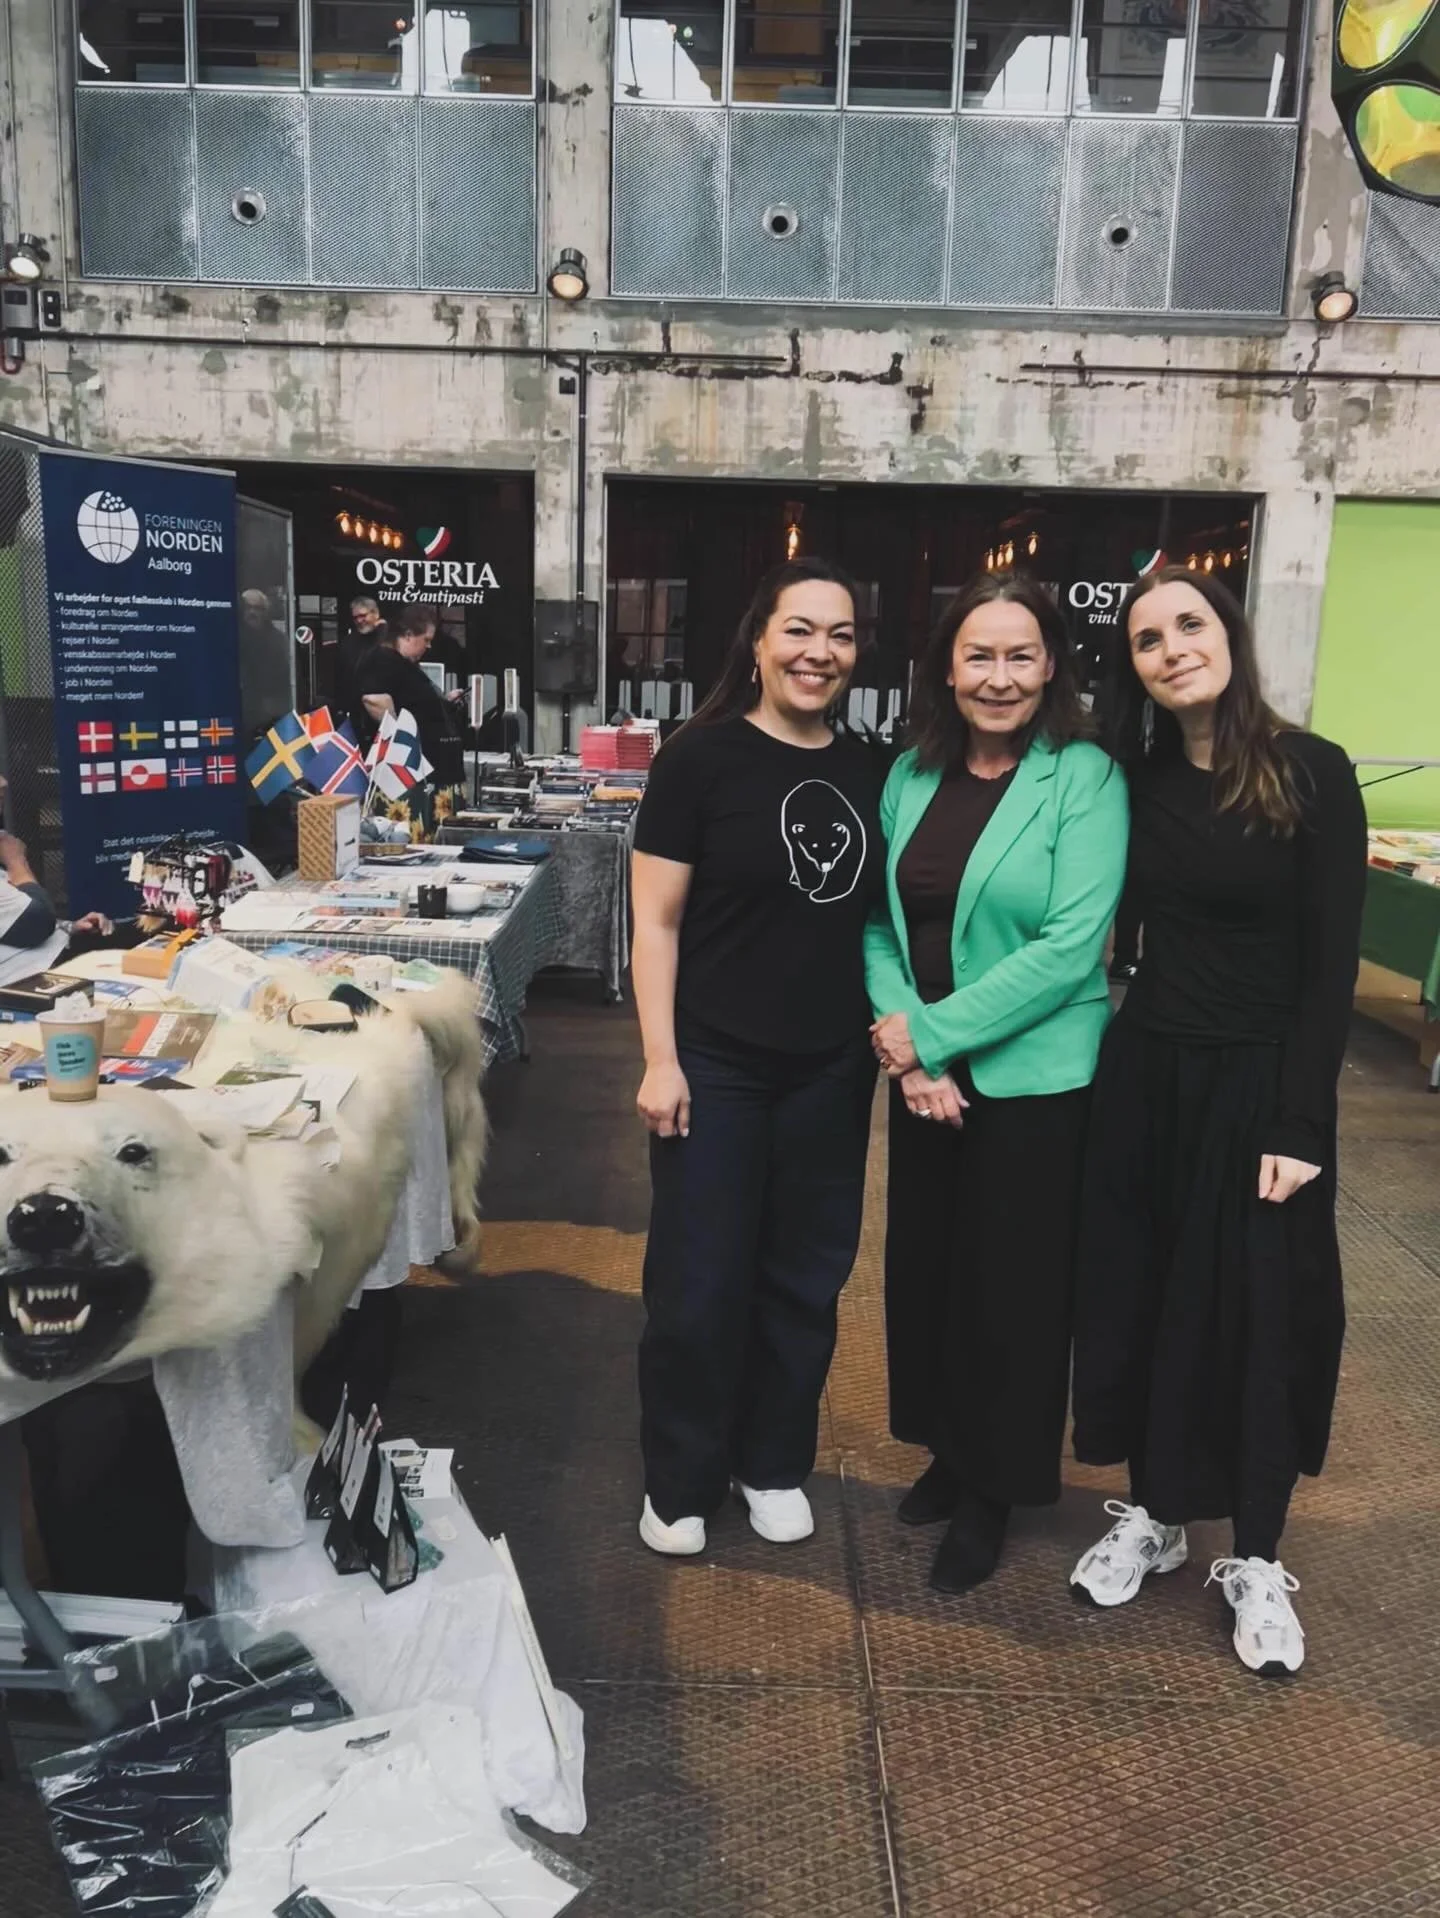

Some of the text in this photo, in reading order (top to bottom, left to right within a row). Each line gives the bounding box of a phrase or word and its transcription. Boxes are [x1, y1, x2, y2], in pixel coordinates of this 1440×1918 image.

[145, 513, 222, 532] FORENINGEN
[146, 529, 223, 553] NORDEN
[148, 556, 192, 575] Aalborg
[356, 558, 500, 588] OSTERIA
[54, 591, 64, 601] Vi
[65, 593, 100, 604] arbejder
[101, 593, 113, 603] for
[178, 597, 204, 607] Norden
[60, 606, 139, 619] foredrag om Norden
[169, 624, 196, 633] Norden
[92, 636, 120, 645] Norden
[150, 650, 177, 659] Norden
[129, 664, 158, 673] Norden
[65, 678, 79, 688] job
[84, 678, 113, 687] Norden
